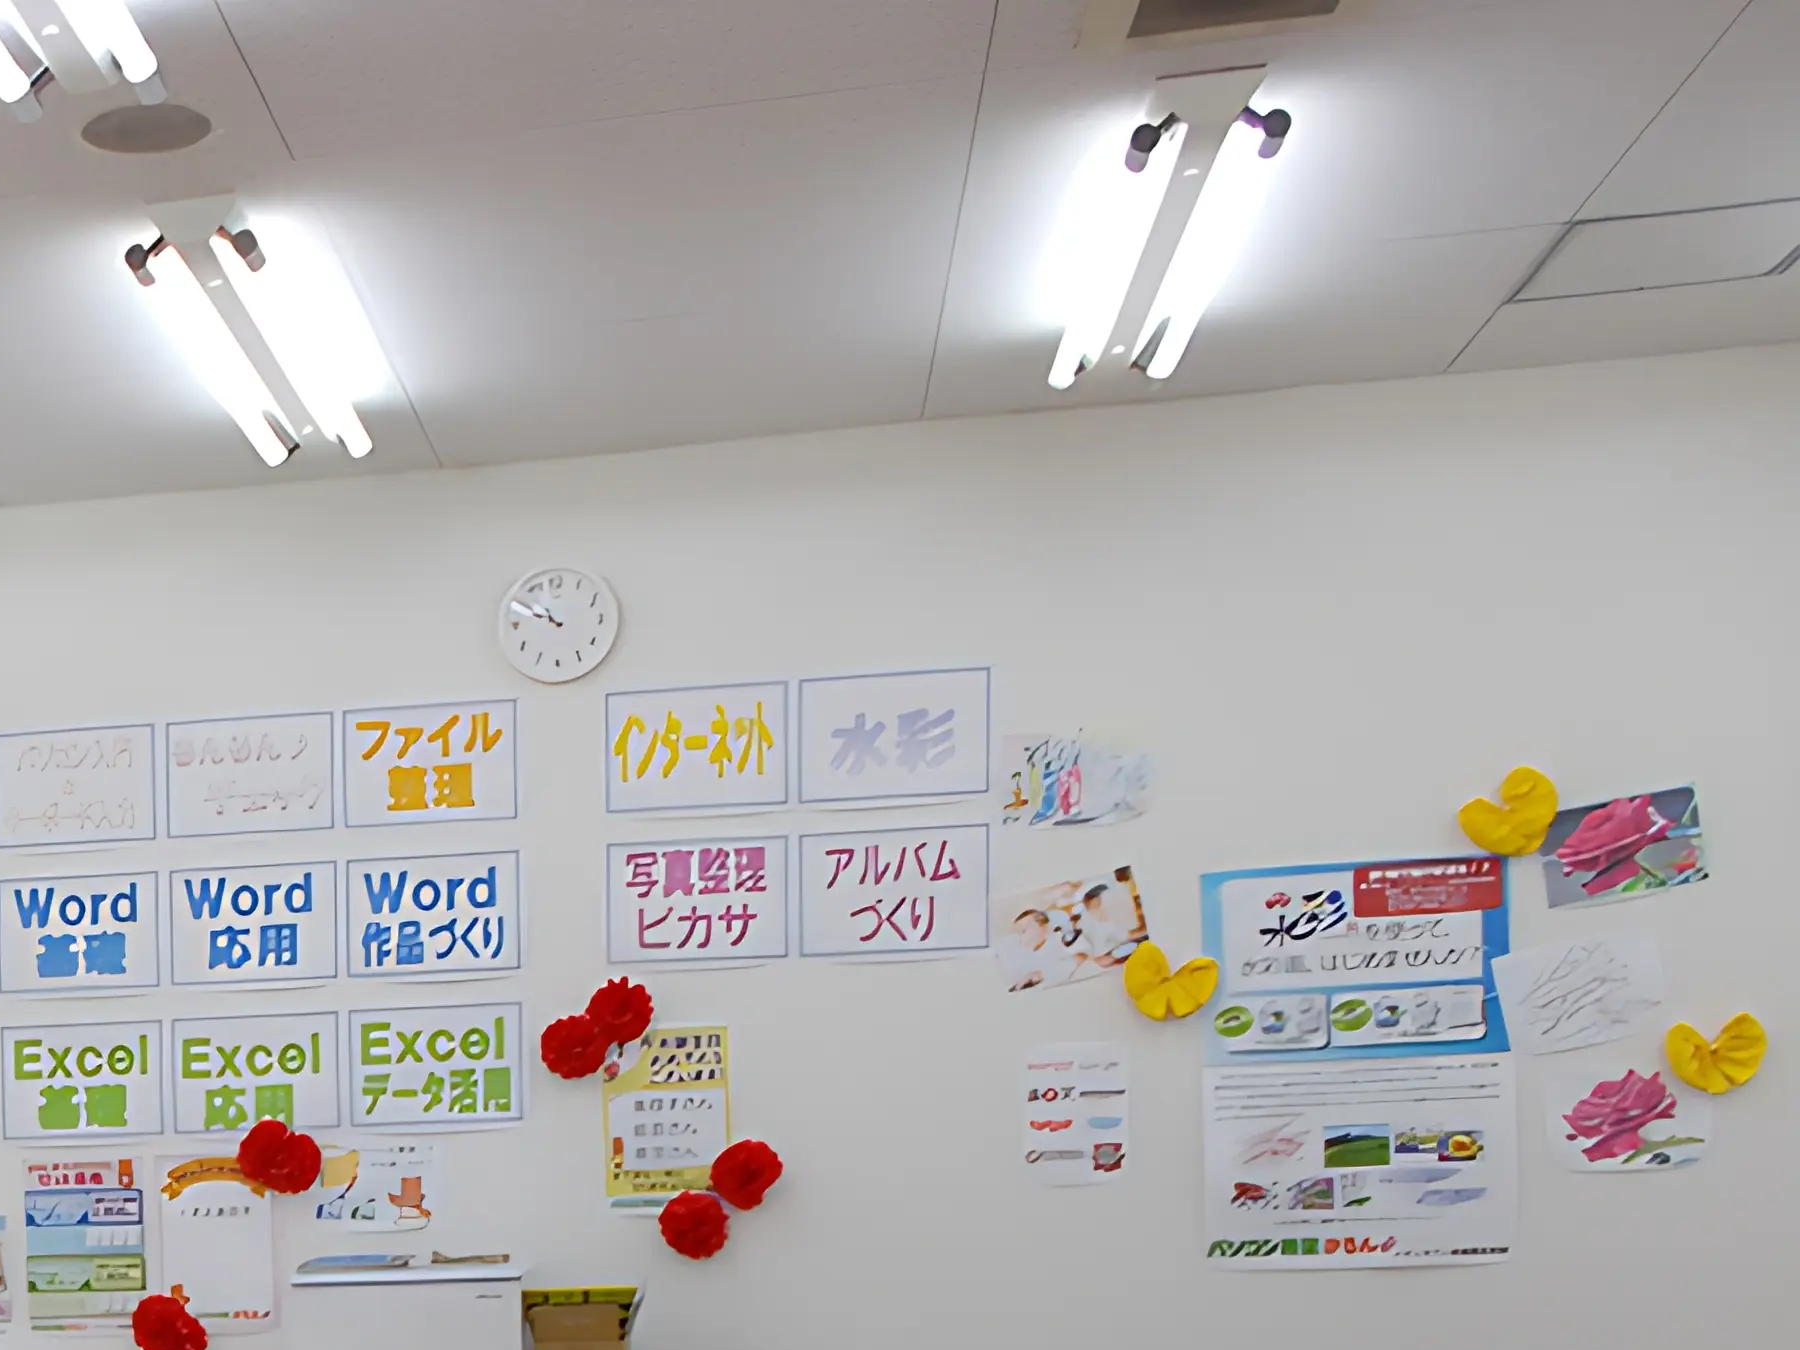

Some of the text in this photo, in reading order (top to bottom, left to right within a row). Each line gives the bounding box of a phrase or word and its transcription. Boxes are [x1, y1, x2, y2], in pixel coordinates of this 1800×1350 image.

[355, 712, 503, 762] ファイル
[13, 881, 138, 928] Word
[184, 871, 313, 920] Word
[363, 866, 497, 914] Word
[362, 915, 505, 968] 作品づくり
[850, 896, 935, 942] づくり
[13, 1035, 148, 1080] Excel
[182, 1033, 320, 1080] Excel
[361, 1017, 504, 1066] Excel
